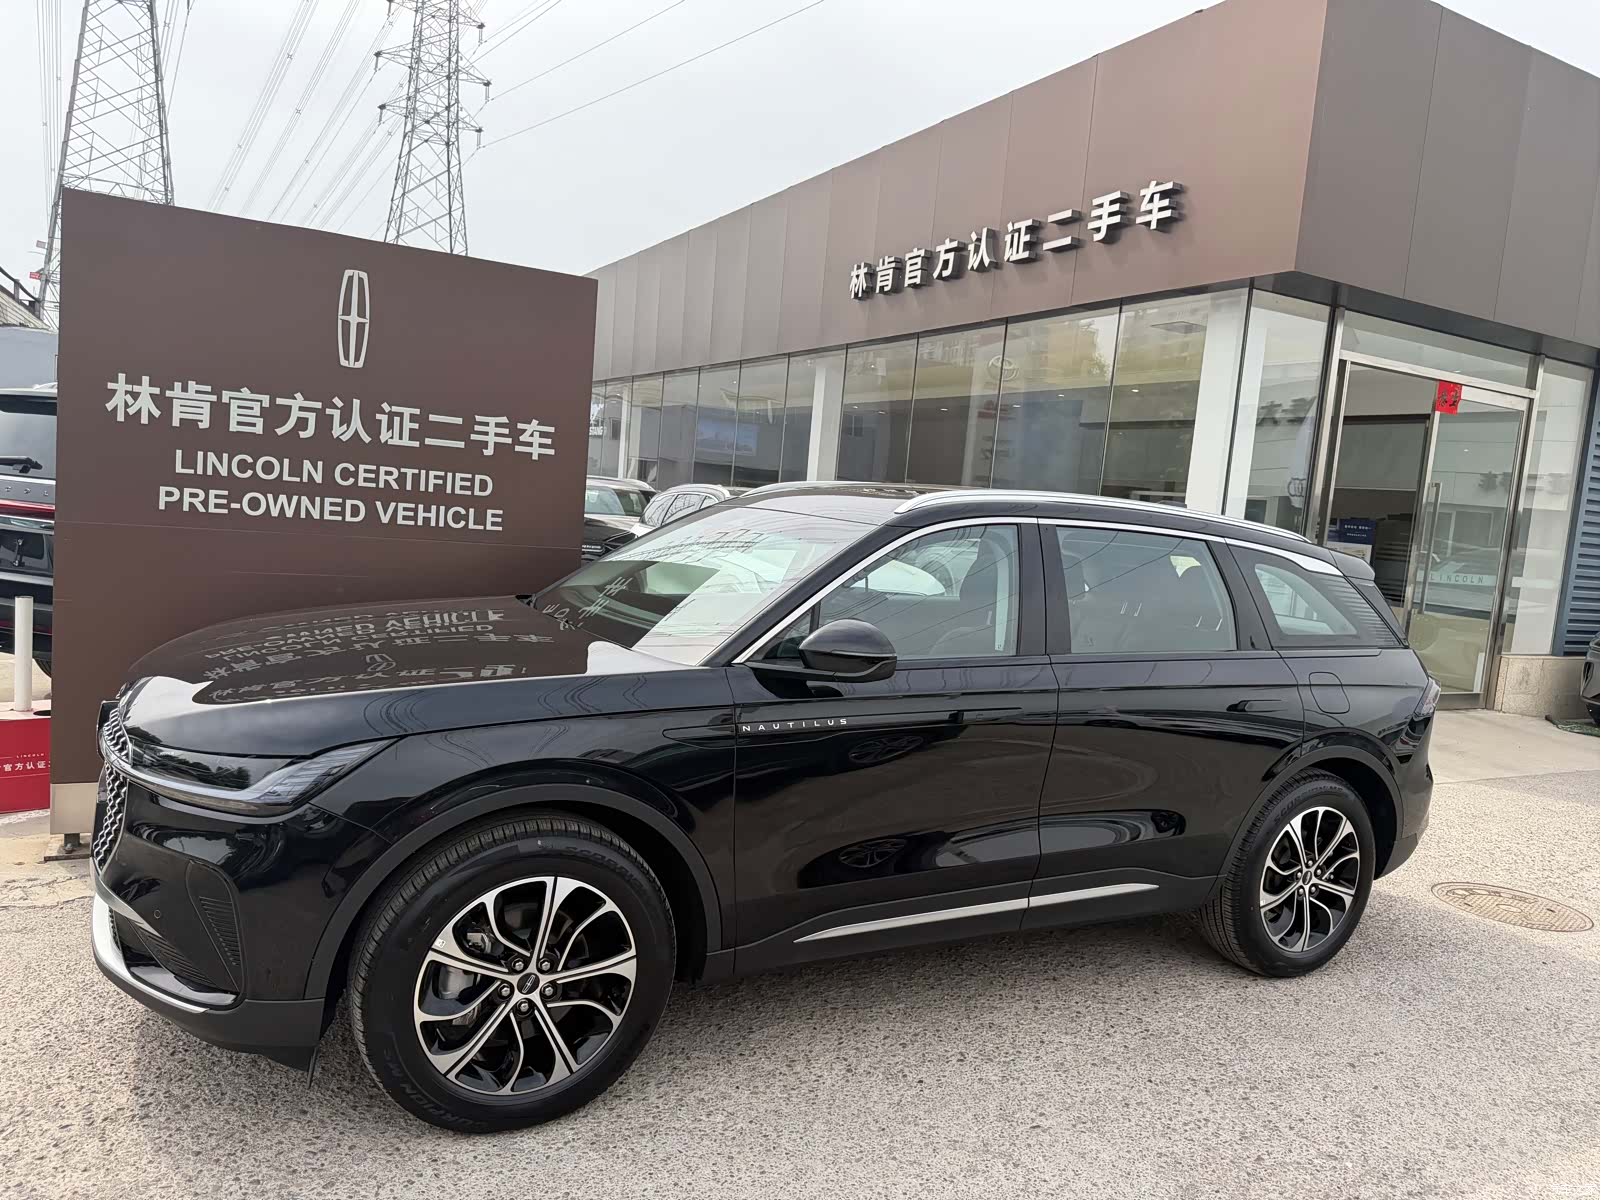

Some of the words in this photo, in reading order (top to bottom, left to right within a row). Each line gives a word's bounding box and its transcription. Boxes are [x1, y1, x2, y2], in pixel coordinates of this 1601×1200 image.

[849, 180, 1182, 300] 林肯官方认证二手车
[105, 373, 555, 460] 林肯官方认证二手车
[175, 449, 323, 484] LINCOLN
[334, 462, 493, 497] CERTIFIED
[158, 486, 366, 522] PRE-OWNED
[375, 501, 503, 531] VEHICLE
[1431, 573, 1484, 584] LINCOLN
[742, 718, 847, 732] NAUTILUS
[0, 760, 50, 772] 官方认证
